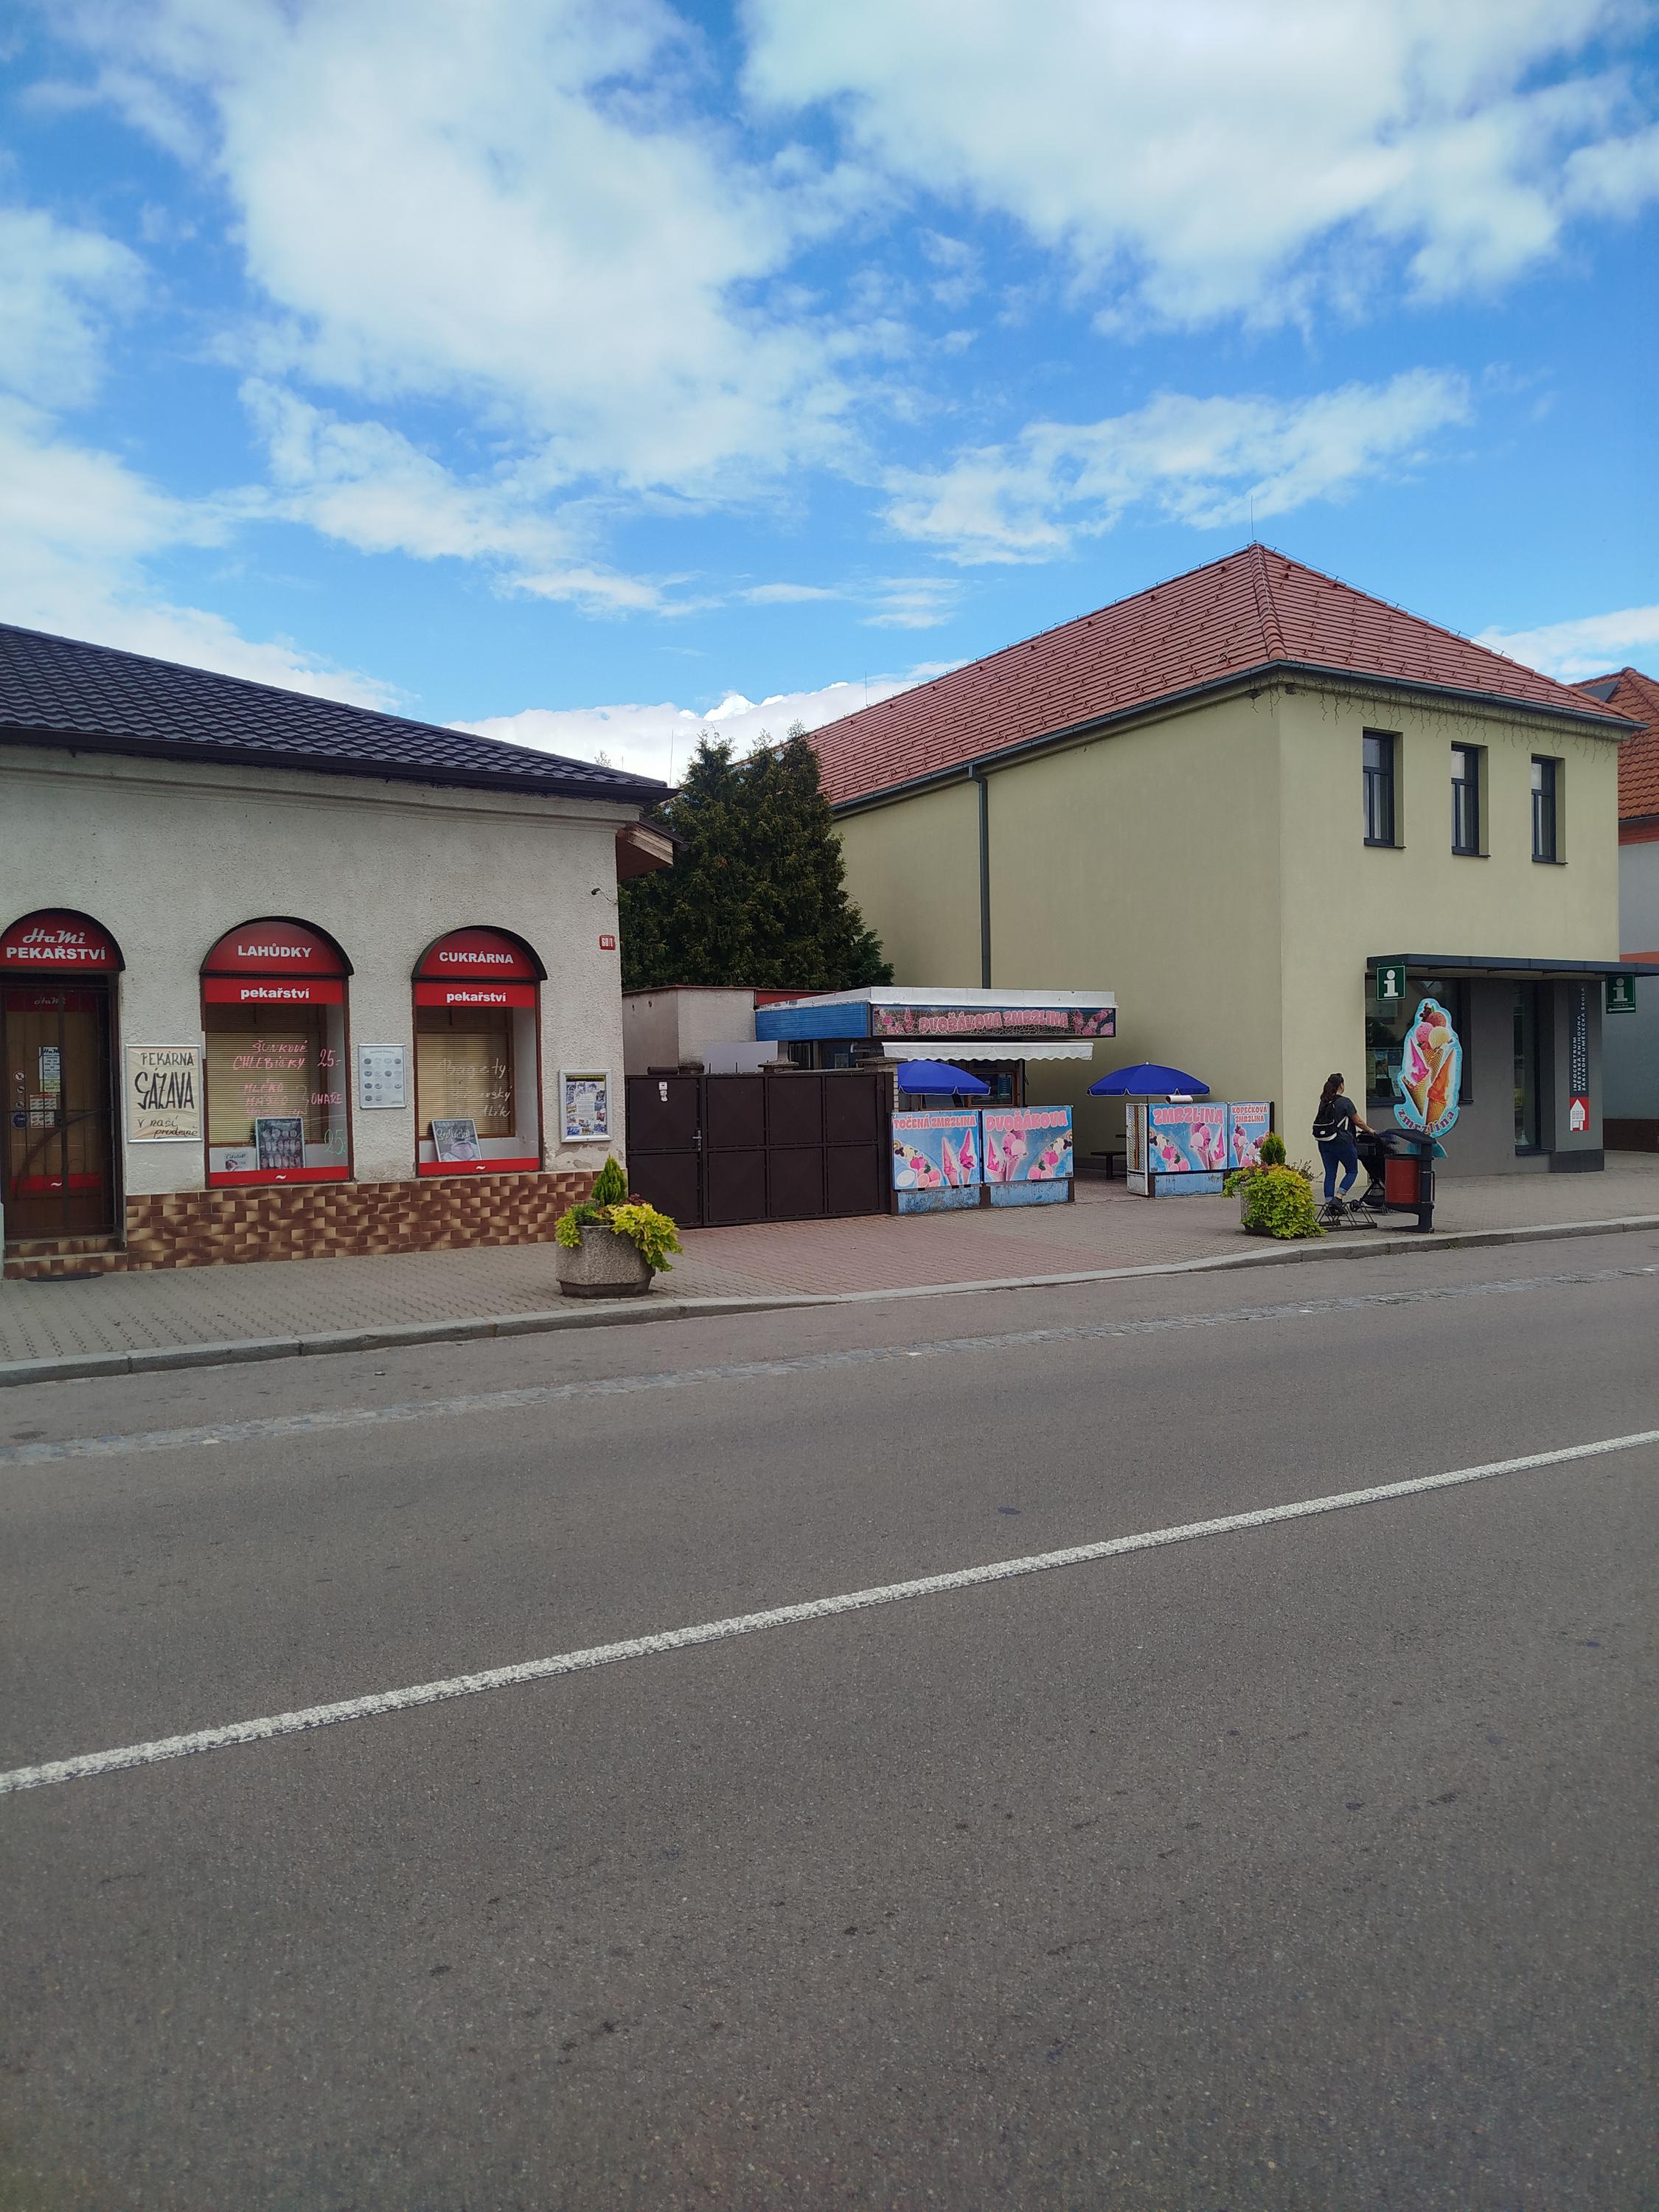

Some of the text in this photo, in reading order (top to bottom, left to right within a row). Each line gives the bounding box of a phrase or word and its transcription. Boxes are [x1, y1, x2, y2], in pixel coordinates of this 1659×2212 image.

[23, 928, 86, 944] HaMi
[6, 946, 105, 960] PEKAŘSTVÍ
[237, 943, 312, 957] LAHŮDKY
[439, 951, 514, 964] CUKRÁRNA
[240, 987, 310, 1000] pekařství
[446, 991, 507, 1003] pekařství
[919, 1010, 1068, 1033] DVOŘÁKOVA ZMRZLINA
[141, 1051, 195, 1065] PEKÁRNA
[134, 1068, 195, 1110] SÁZAVA
[1231, 1103, 1268, 1114] KOPEČKOVÁ
[893, 1114, 977, 1130] TOČENÁ ZMRZLINA
[985, 1109, 1068, 1131] DVOŘÁKOVA
[1152, 1107, 1224, 1125] ZMRZLINA
[1234, 1115, 1265, 1123] ZMRZLINA
[1398, 1108, 1455, 1134] zmrzlina
